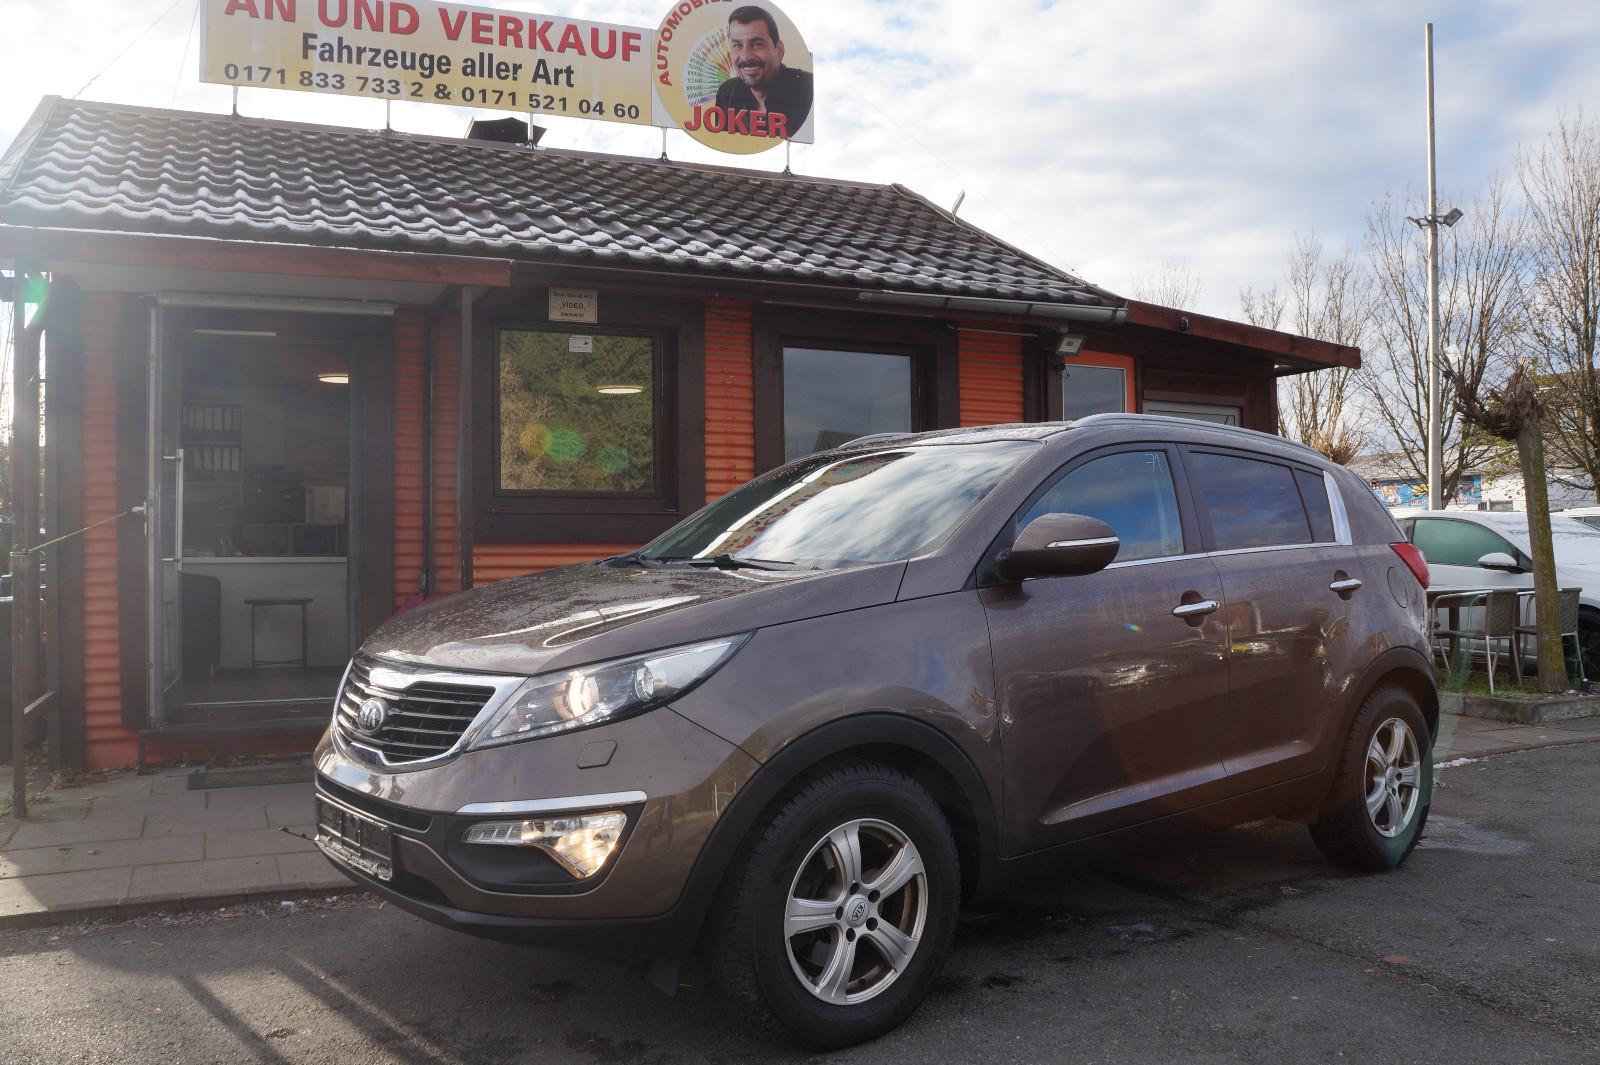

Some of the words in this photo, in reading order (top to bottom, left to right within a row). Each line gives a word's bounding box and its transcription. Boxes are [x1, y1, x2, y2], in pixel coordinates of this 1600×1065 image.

[224, 0, 296, 23] AN
[318, 0, 420, 35] UND
[438, 7, 642, 62] VERKAUF
[302, 32, 452, 79] Fahrzeuge
[461, 51, 523, 81] aller
[531, 58, 575, 88] Art
[224, 63, 287, 85] 0171
[299, 71, 345, 90] 833
[356, 76, 401, 95] 733
[410, 81, 424, 98] 2
[433, 83, 452, 100] &
[461, 86, 517, 107] 0171
[528, 93, 567, 112] 521
[578, 99, 606, 116] 04
[613, 103, 640, 120] 60
[684, 105, 789, 140] JOKER
